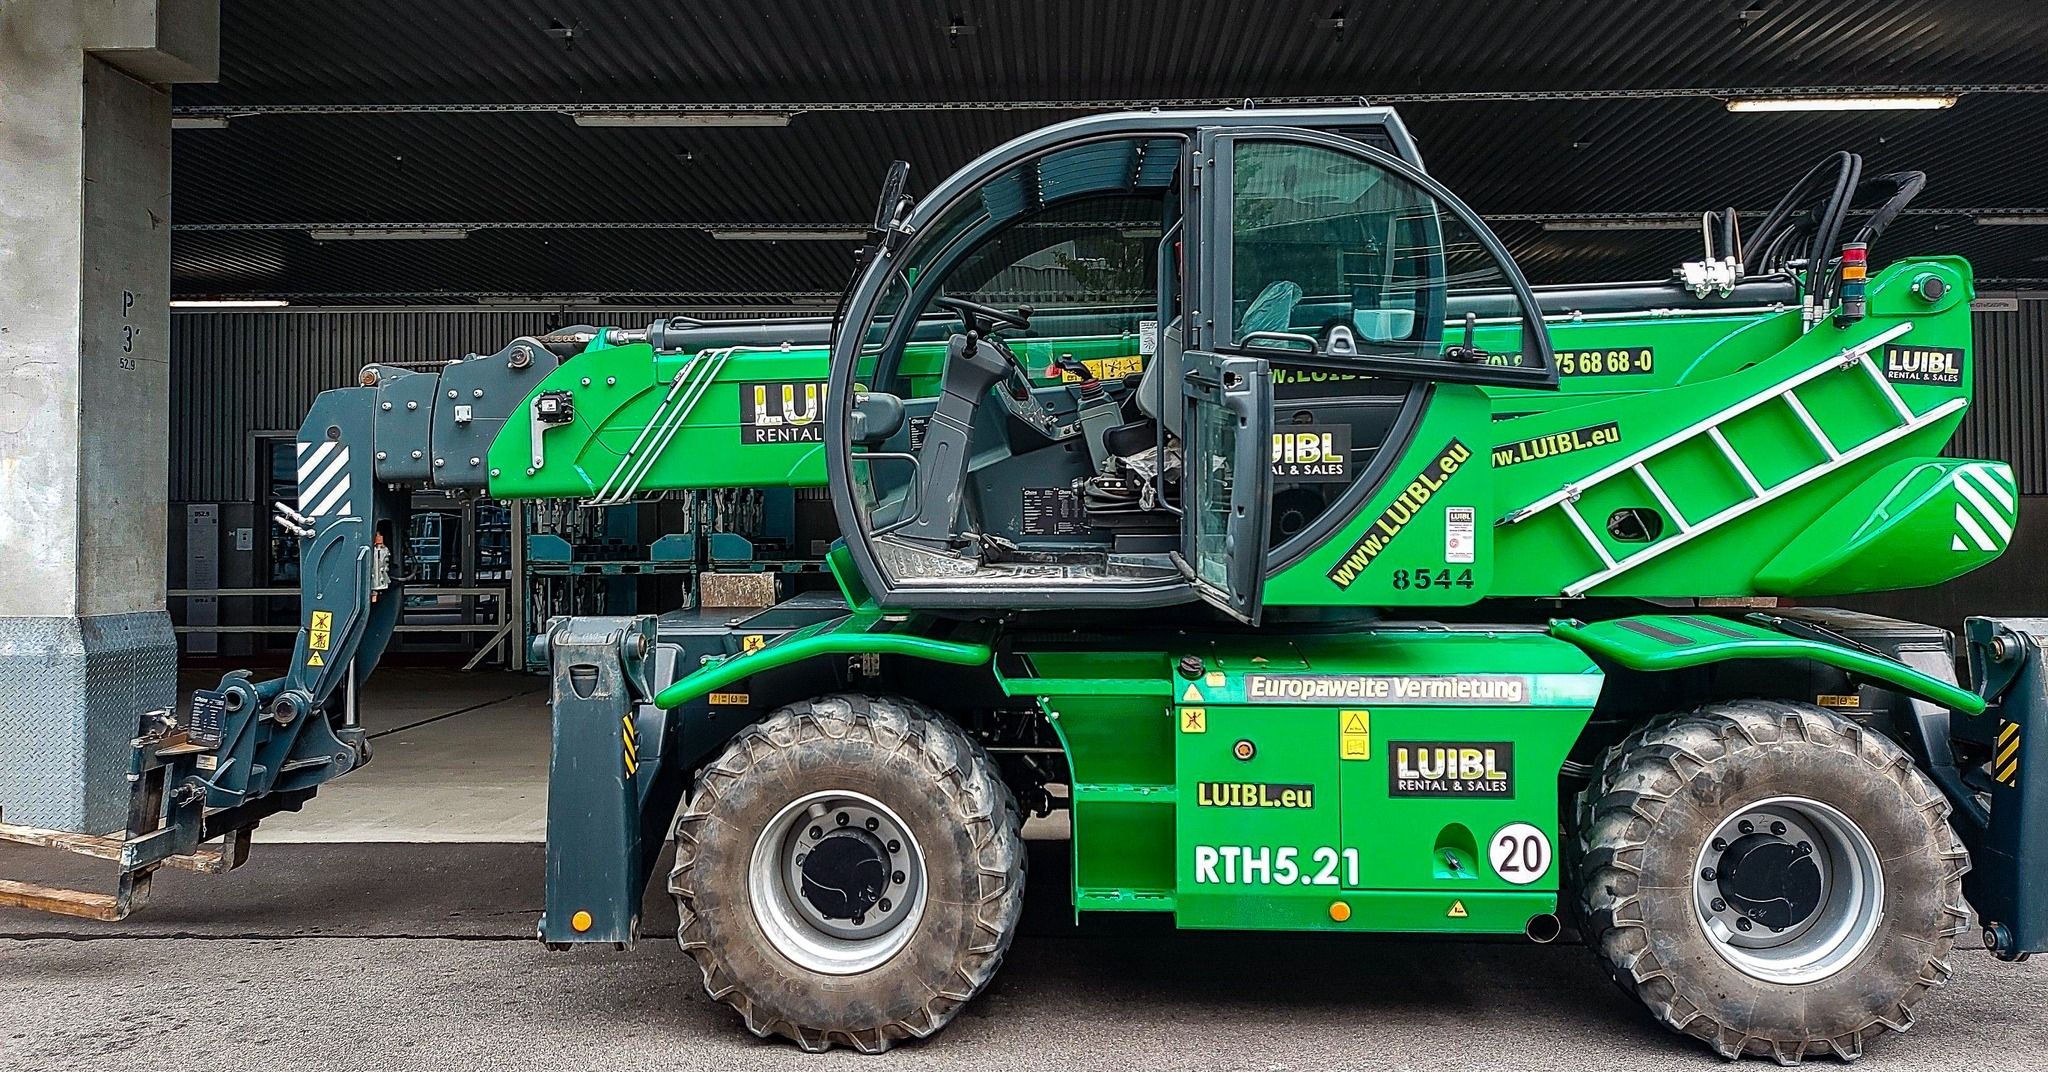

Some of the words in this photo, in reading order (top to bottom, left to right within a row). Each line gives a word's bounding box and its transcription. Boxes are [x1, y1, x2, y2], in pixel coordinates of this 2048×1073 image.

[123, 290, 134, 318] P
[1554, 353, 1575, 374] 75
[1580, 353, 1602, 373] 68
[1608, 351, 1630, 372] 68
[1634, 350, 1651, 371] -0
[1888, 350, 1959, 374] LUIBL
[1888, 371, 1921, 380] RENTAL
[1932, 373, 1959, 382] SALES
[756, 428, 822, 442] RENTAL
[1491, 427, 1619, 468] w.LUIBL.eu
[1290, 465, 1299, 475] &
[1304, 464, 1343, 475] SALES
[1332, 443, 1471, 586] www.LUIBL.eu
[1392, 568, 1474, 590] 8544
[1251, 676, 1389, 701] Europaweite
[1394, 677, 1522, 702] Vermietung
[1398, 748, 1507, 780] LUIBL
[1198, 783, 1312, 808] LUIBL.eu
[1399, 780, 1448, 791] RENTAL
[1453, 781, 1462, 791] &
[1467, 781, 1507, 792] SALES
[1195, 845, 1359, 886] RTH5.21
[1500, 835, 1542, 872] 20
